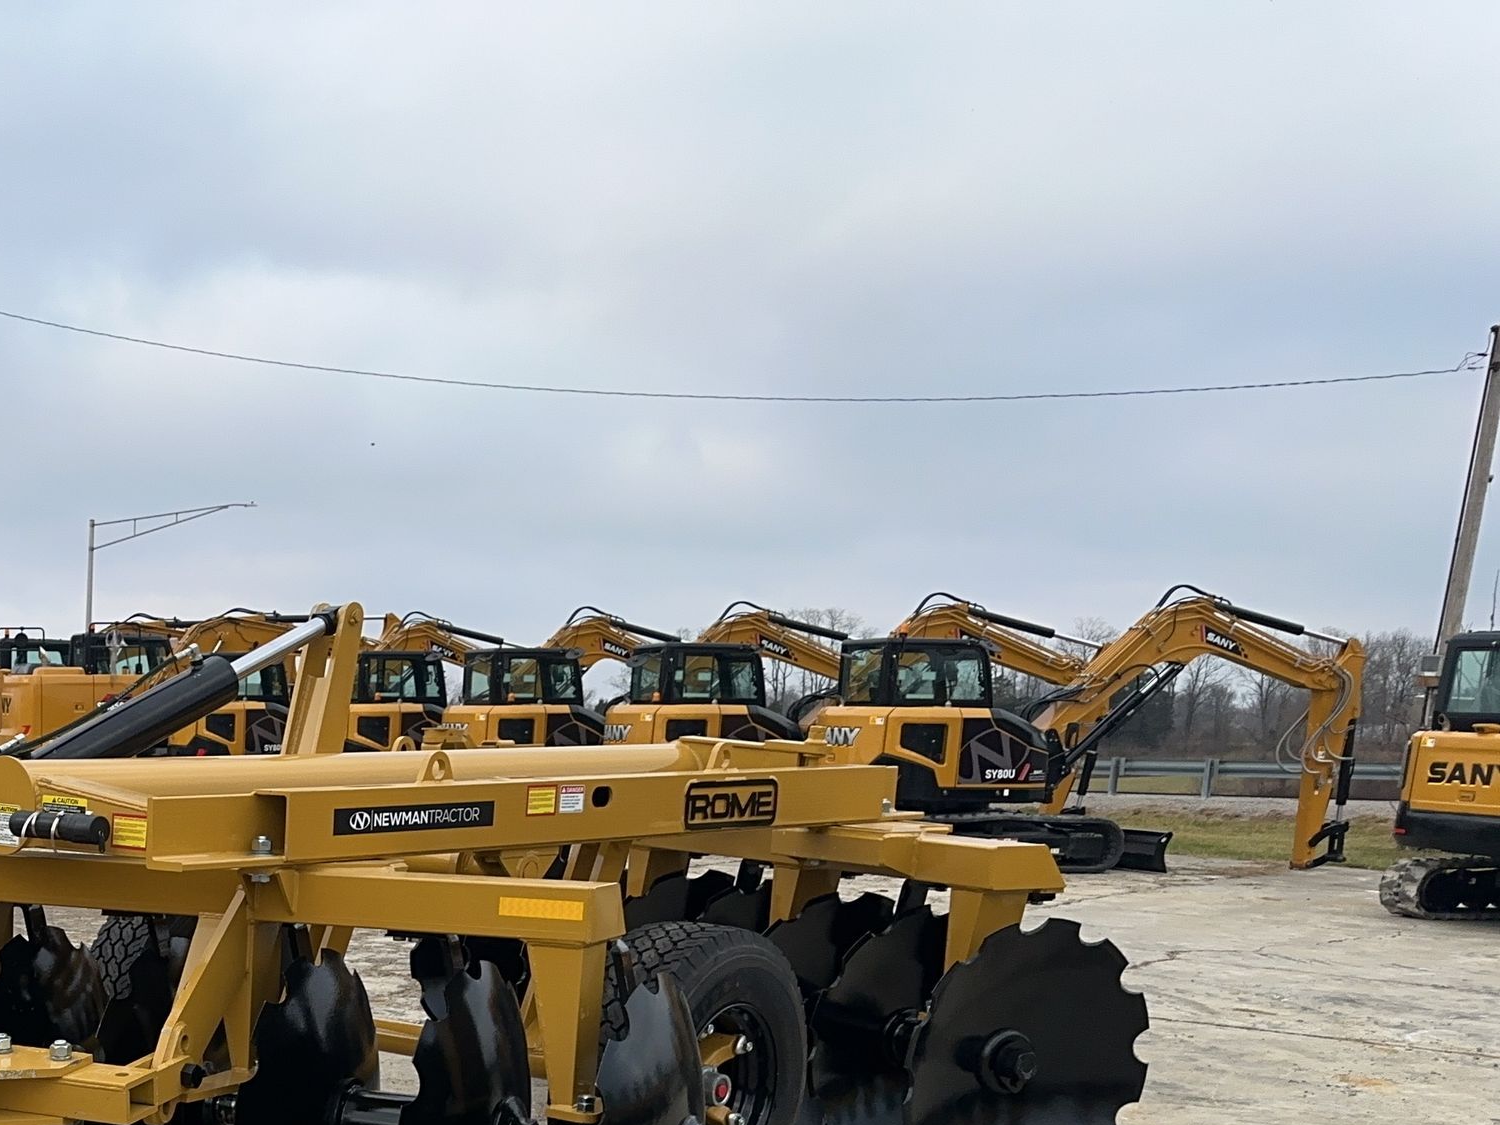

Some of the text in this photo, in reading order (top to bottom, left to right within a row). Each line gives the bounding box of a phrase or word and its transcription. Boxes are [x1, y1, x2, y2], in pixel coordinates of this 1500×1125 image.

[604, 642, 628, 656] SANY
[761, 639, 787, 655] SANY
[1206, 632, 1237, 650] SANY
[825, 726, 861, 745] ANY
[985, 769, 1016, 779] SY80U
[57, 797, 79, 805] CAUTION
[689, 791, 776, 821] ROME
